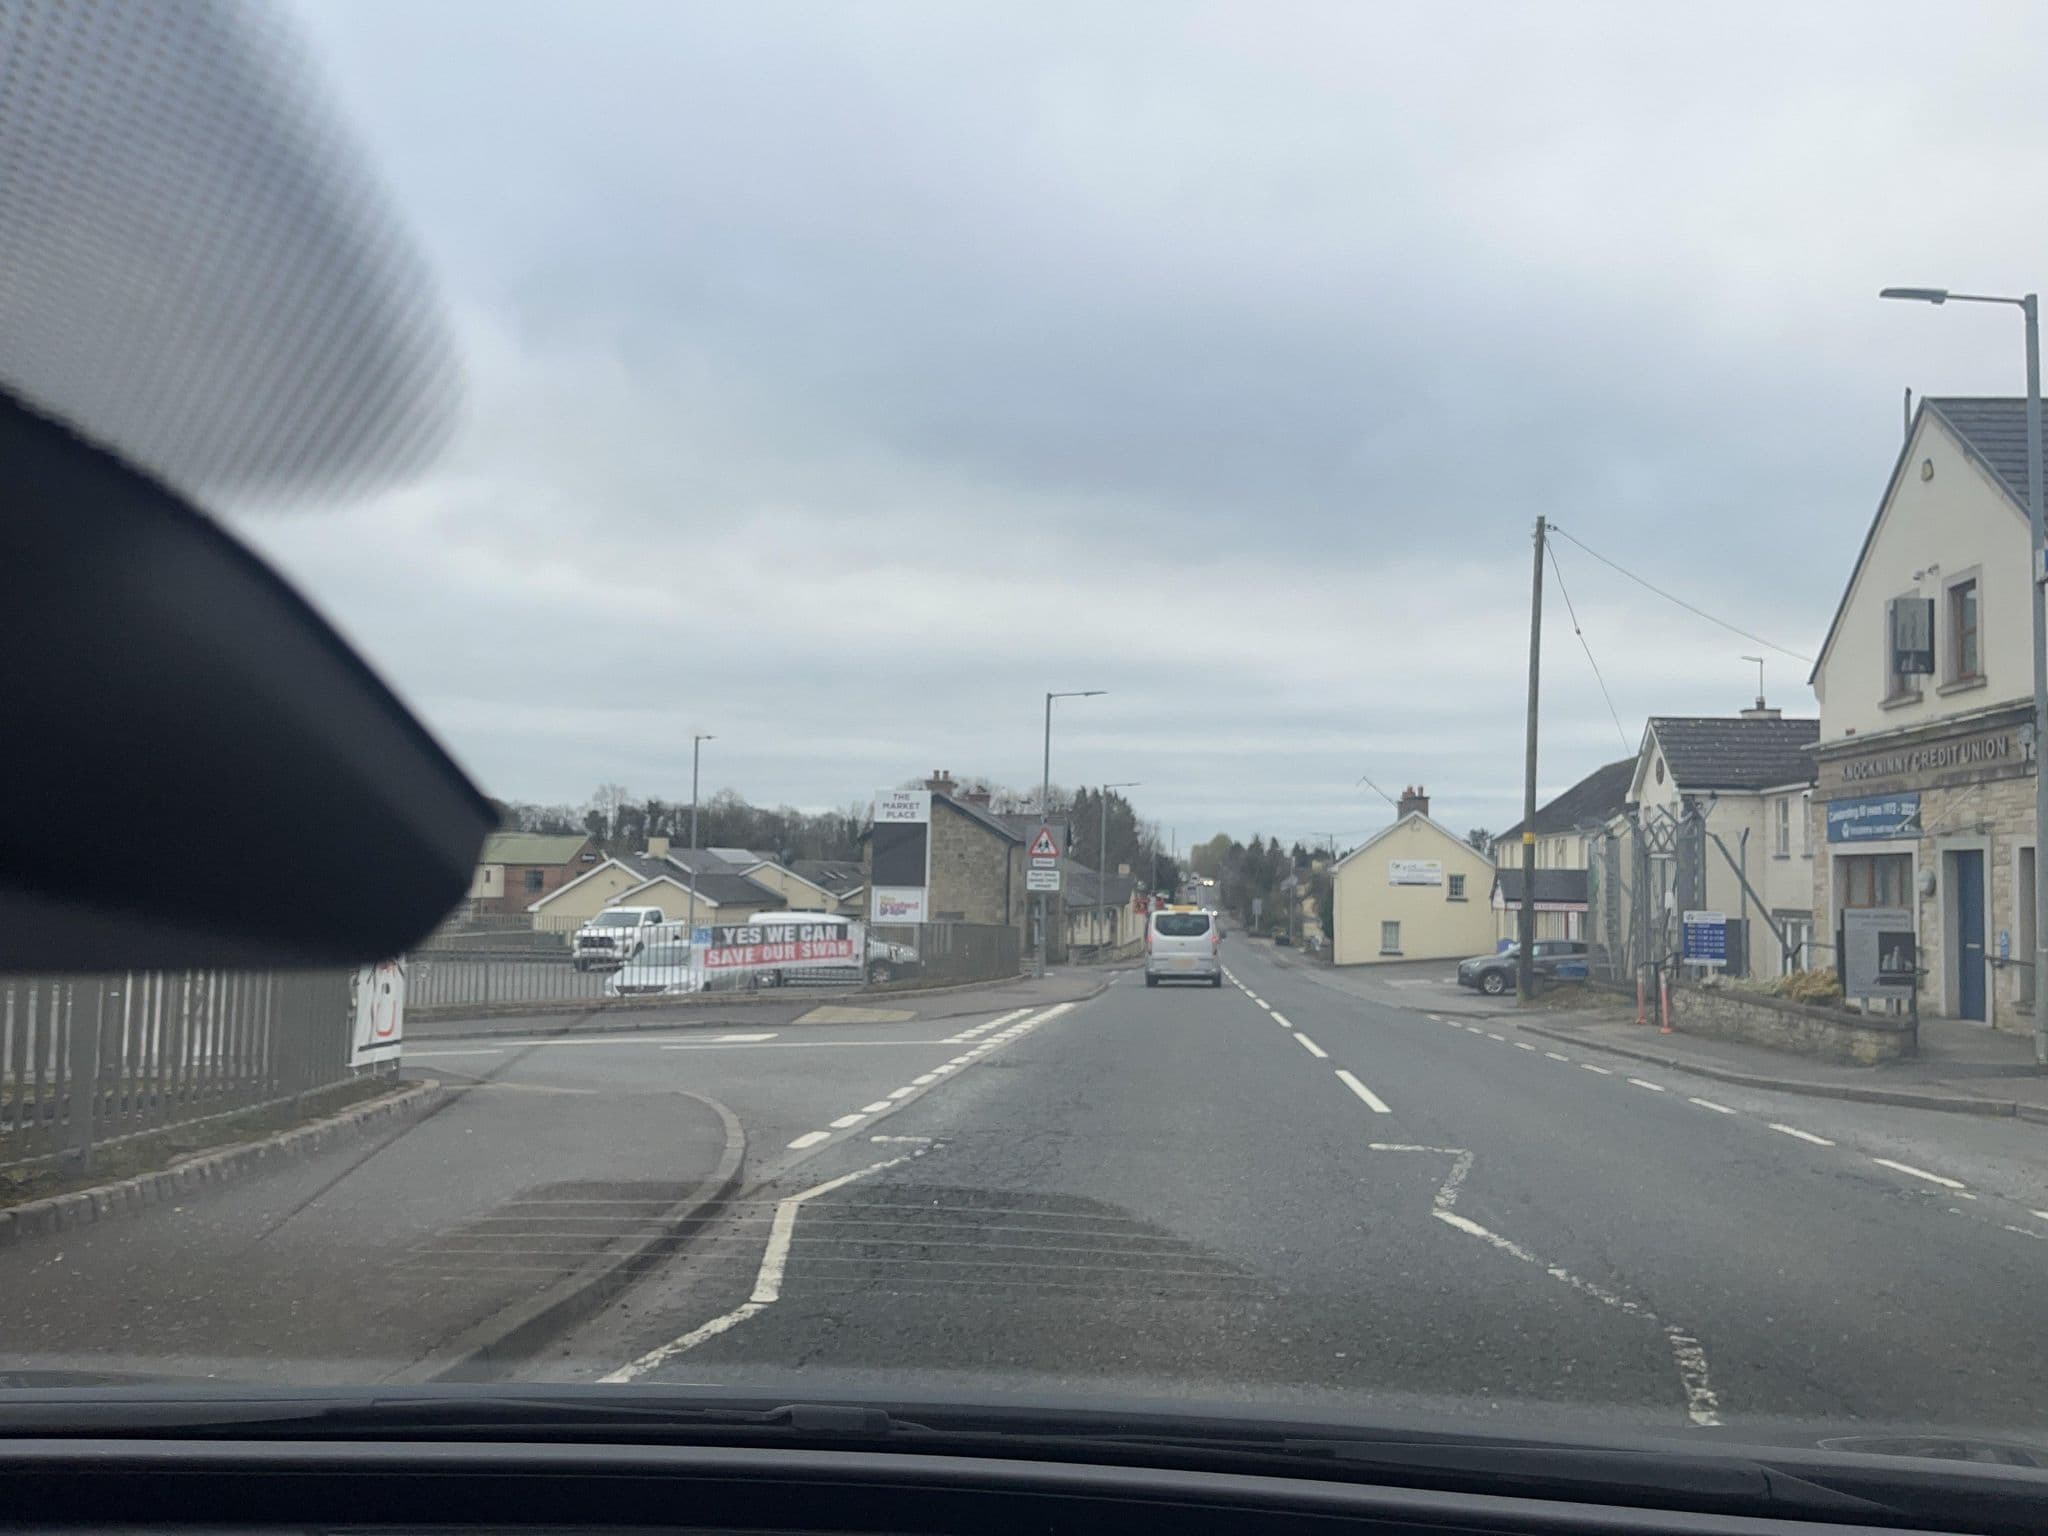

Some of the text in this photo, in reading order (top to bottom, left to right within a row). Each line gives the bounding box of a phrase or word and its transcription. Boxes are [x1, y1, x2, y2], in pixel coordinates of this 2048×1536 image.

[1911, 744, 1958, 771] CREDIT
[1960, 735, 2007, 765] UNION
[893, 793, 910, 801] THE
[886, 811, 916, 819] PLACE
[722, 927, 761, 944] YES
[766, 925, 795, 942] WE
[801, 924, 838, 942] CAN
[708, 948, 754, 965] SAVE
[762, 944, 795, 960] OUR
